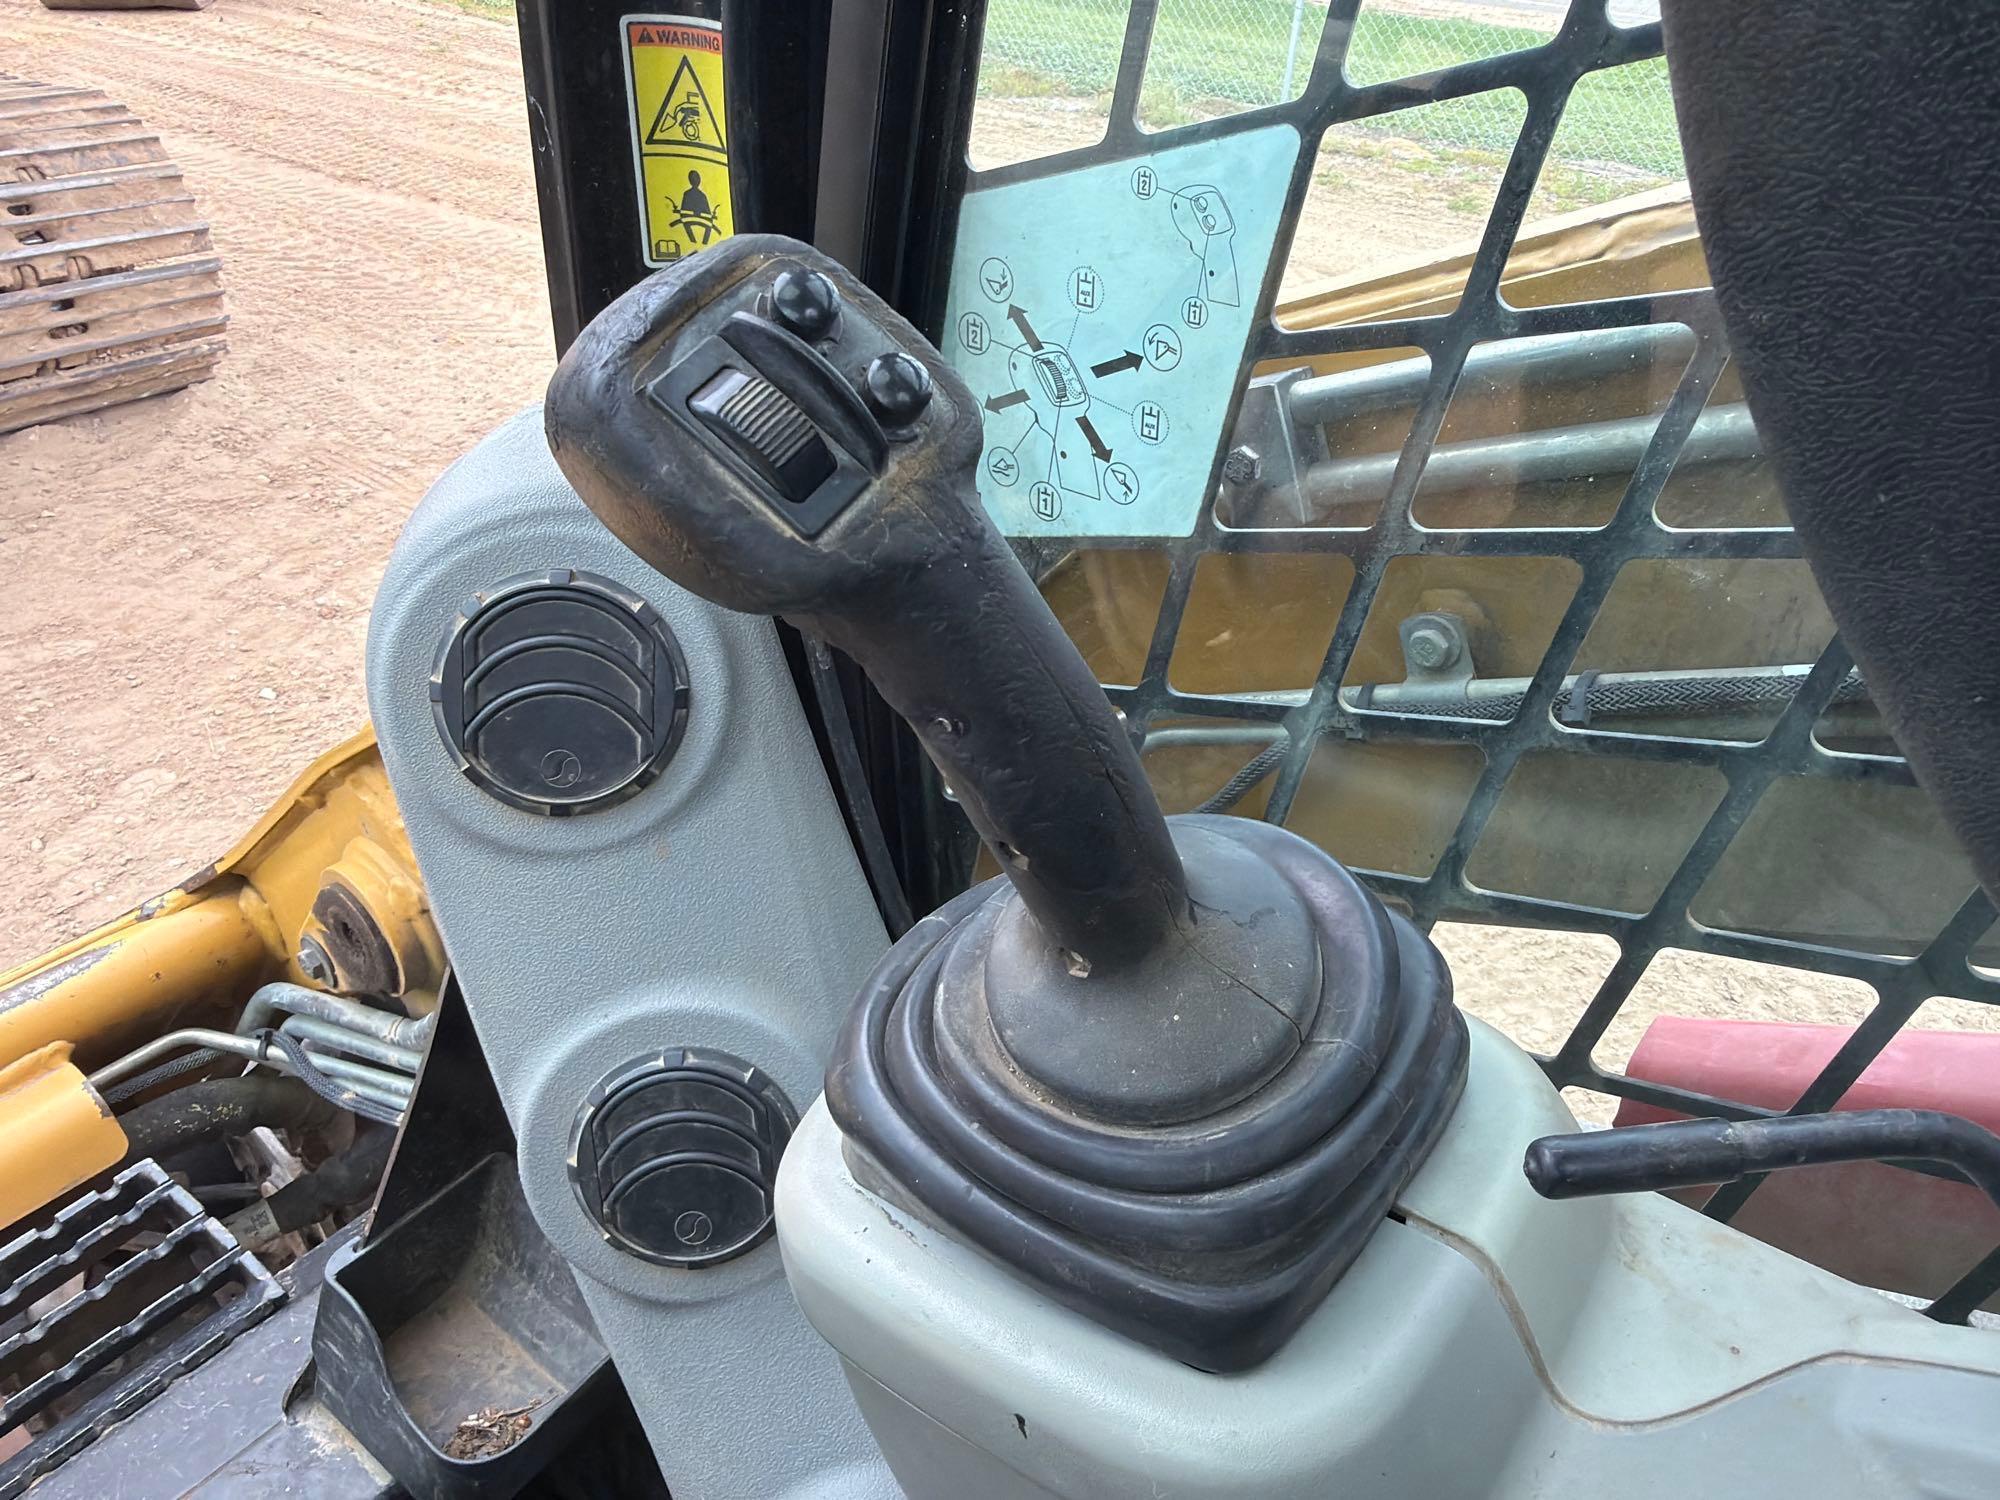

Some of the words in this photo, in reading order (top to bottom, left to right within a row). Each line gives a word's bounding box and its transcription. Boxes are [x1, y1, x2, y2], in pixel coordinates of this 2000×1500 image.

[656, 29, 720, 51] WARNING
[1141, 180, 1148, 191] 2
[971, 330, 978, 344] 2
